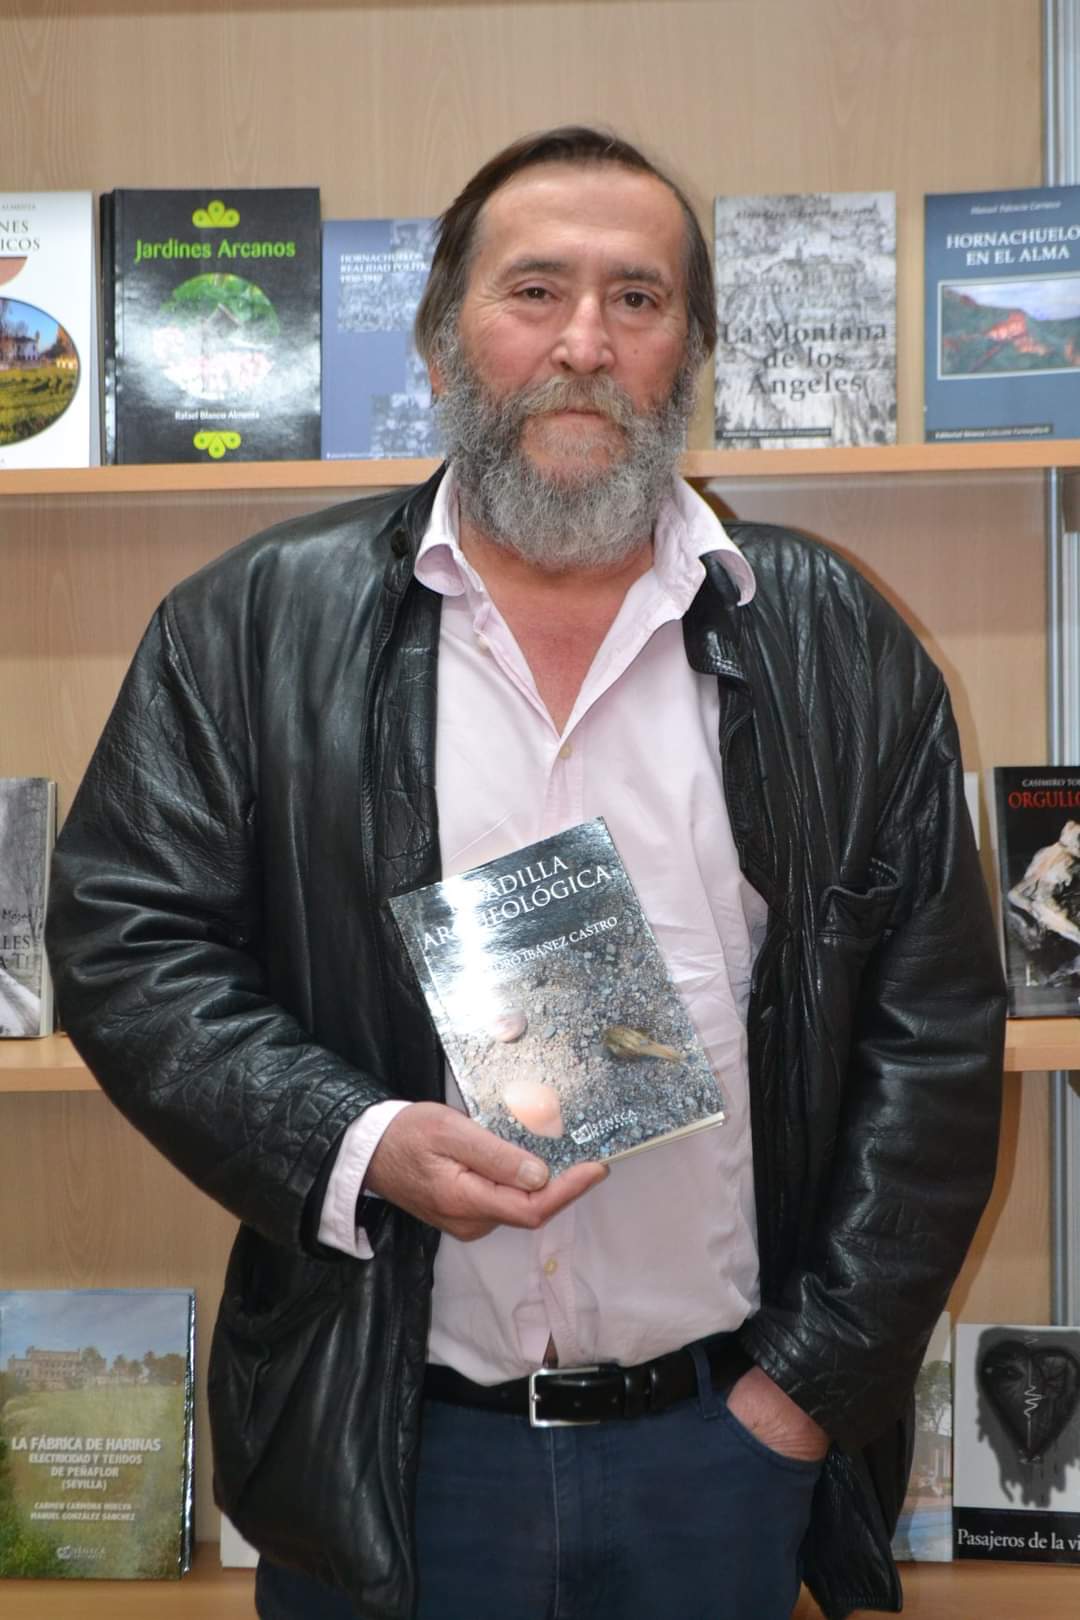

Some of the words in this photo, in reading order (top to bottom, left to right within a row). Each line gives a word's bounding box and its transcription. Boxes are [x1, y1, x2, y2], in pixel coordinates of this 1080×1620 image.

[1, 237, 40, 252] ICOS
[946, 224, 1080, 249] HORNACHUELO
[134, 237, 212, 264] Jardines
[217, 239, 296, 259] Arcanos
[966, 250, 989, 266] EN
[994, 247, 1015, 265] EL
[1019, 244, 1070, 263] ALMA
[392, 260, 432, 273] POLÍTIC
[722, 322, 752, 345] La
[762, 346, 794, 369] de
[807, 346, 847, 369] los
[424, 865, 612, 951] AREOLÓGICA
[521, 934, 569, 962] IBÁÑEZ
[569, 916, 618, 944] CASTRO
[12, 1437, 27, 1451] LA
[30, 1434, 82, 1451] FÁBRICA
[85, 1437, 103, 1451] DE
[105, 1438, 162, 1451] HARINAS
[93, 1454, 99, 1464] Y
[51, 1466, 64, 1477] DE
[67, 1464, 119, 1478] PEÑAFLOR
[62, 1479, 107, 1491] (SEVILLA)
[957, 1528, 1025, 1551] Pasajeros
[1028, 1531, 1048, 1549] de
[1051, 1532, 1064, 1550] la
